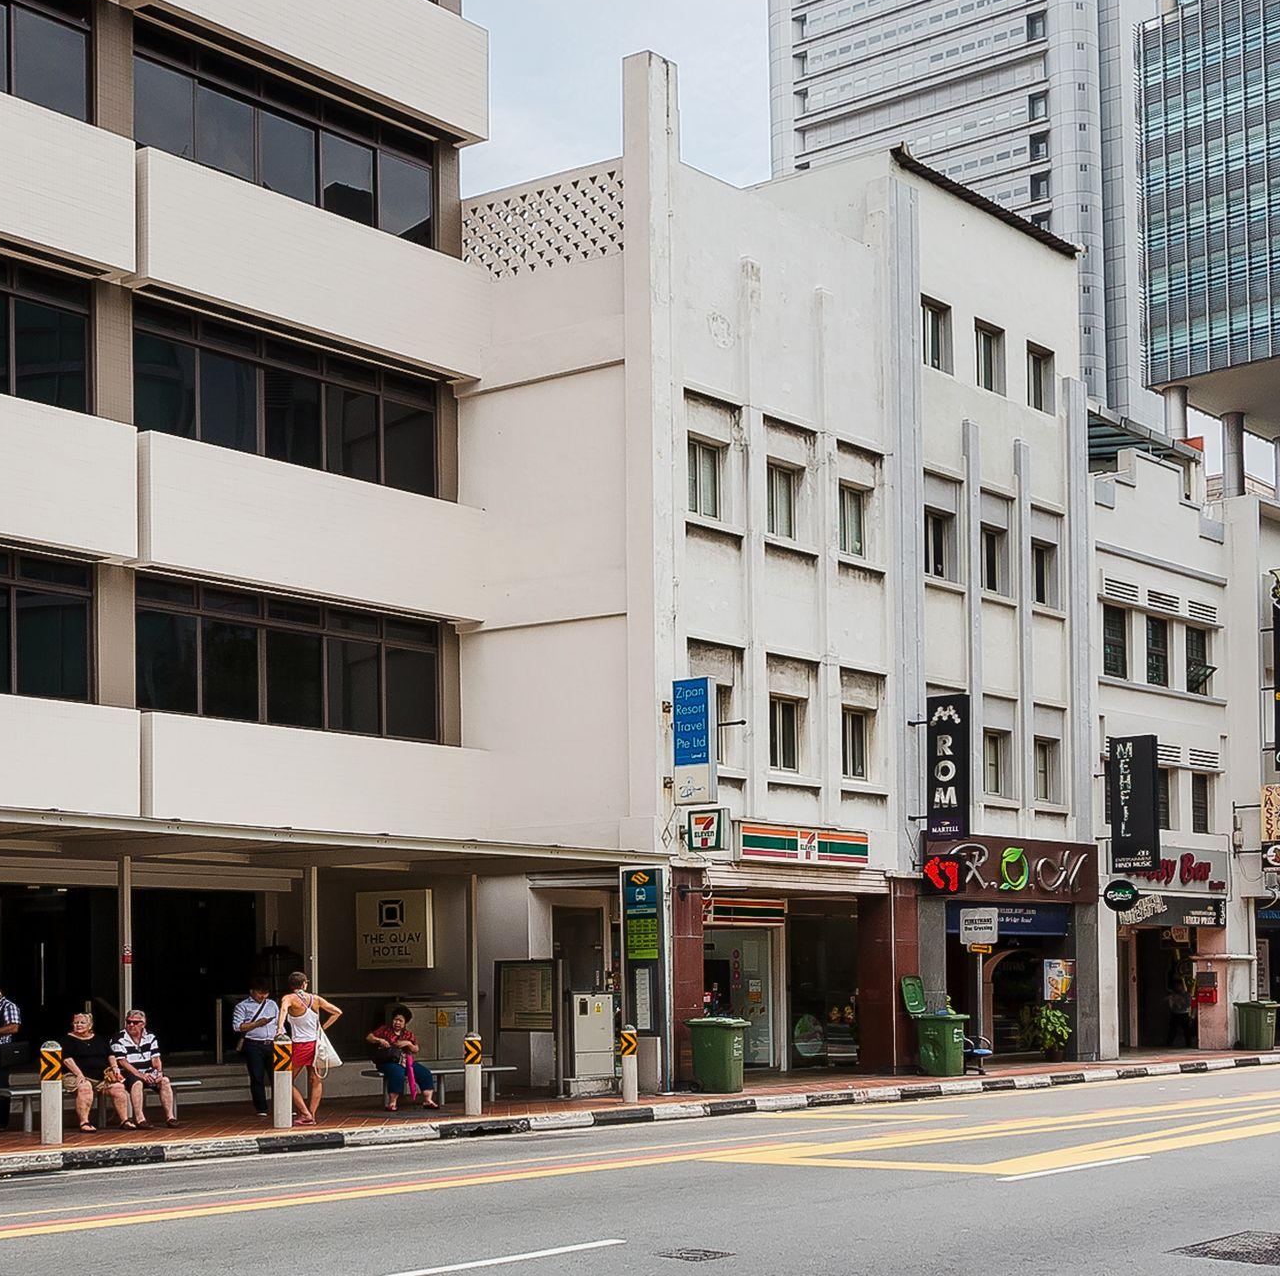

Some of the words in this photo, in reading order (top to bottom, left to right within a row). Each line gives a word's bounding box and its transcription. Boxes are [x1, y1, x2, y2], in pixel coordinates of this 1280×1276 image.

[676, 686, 704, 700] Zipan
[676, 703, 705, 716] Resort
[676, 718, 706, 732] Travel
[676, 738, 690, 749] Pte
[693, 736, 706, 748] Ltd
[1264, 785, 1274, 840] SASSY
[932, 825, 960, 833] MARTELL
[362, 934, 386, 944] THE
[389, 932, 422, 943] QUAY
[372, 945, 411, 957] HOTEL
